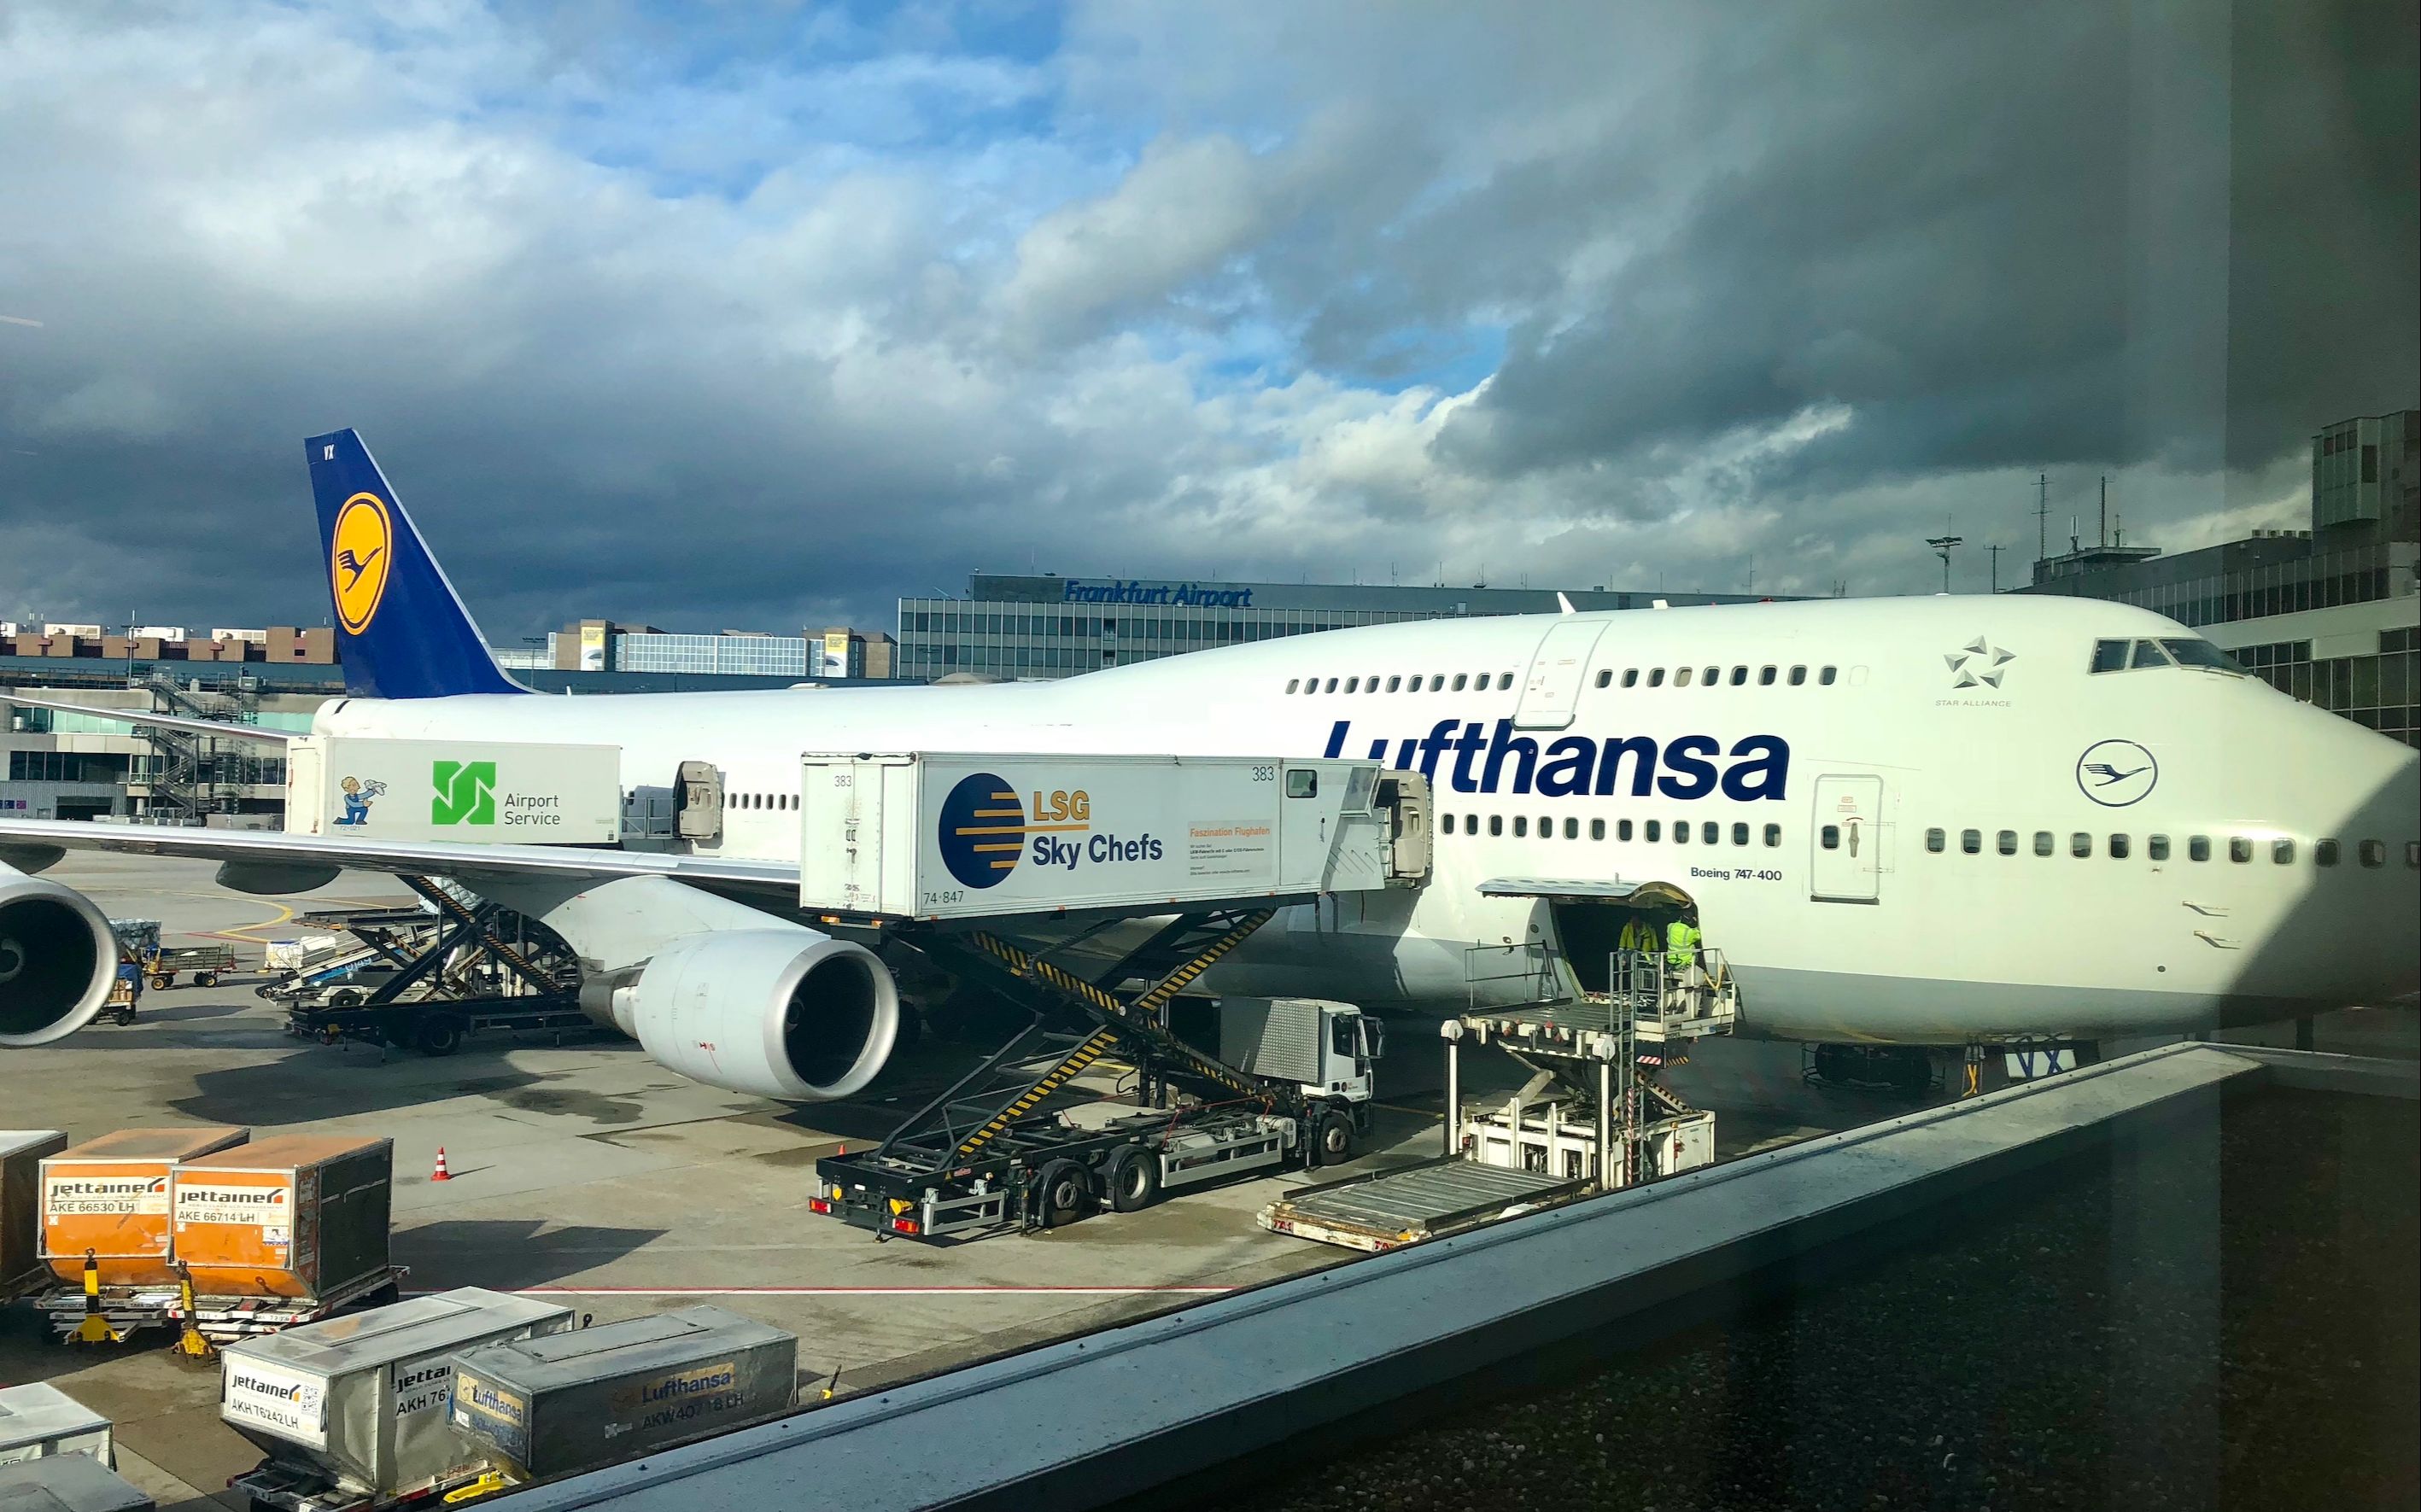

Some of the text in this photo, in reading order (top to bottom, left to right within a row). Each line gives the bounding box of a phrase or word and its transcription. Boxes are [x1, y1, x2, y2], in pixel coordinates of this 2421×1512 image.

[324, 444, 335, 461] VX
[1064, 580, 1254, 608] Frankfurt Airport
[833, 775, 852, 787] 383
[1252, 766, 1275, 782] 383
[504, 792, 559, 811] Airport
[1033, 790, 1091, 821] LSG
[504, 811, 561, 826] Service
[1190, 826, 1271, 838] Faszination Flughafen
[1032, 833, 1163, 871] Sky Chefs
[1690, 867, 1783, 881] Boeing 747-400
[2016, 1048, 2064, 1079] VX
[50, 1177, 166, 1197] jettainer
[178, 1188, 284, 1204] jettainer
[50, 1201, 135, 1213] AKE 66530 LH
[178, 1211, 255, 1223] AKE 66714 LH
[231, 1375, 301, 1400] jettainer
[396, 1366, 451, 1394] jettai
[642, 1371, 731, 1404] Lufthansa
[231, 1398, 253, 1416] AKH
[254, 1405, 284, 1424] 76242
[285, 1415, 299, 1429] LH
[396, 1391, 426, 1416] AKH
[471, 1384, 523, 1422] Lufthansa
[642, 1409, 675, 1431] AKW
[727, 1392, 744, 1410] LH
